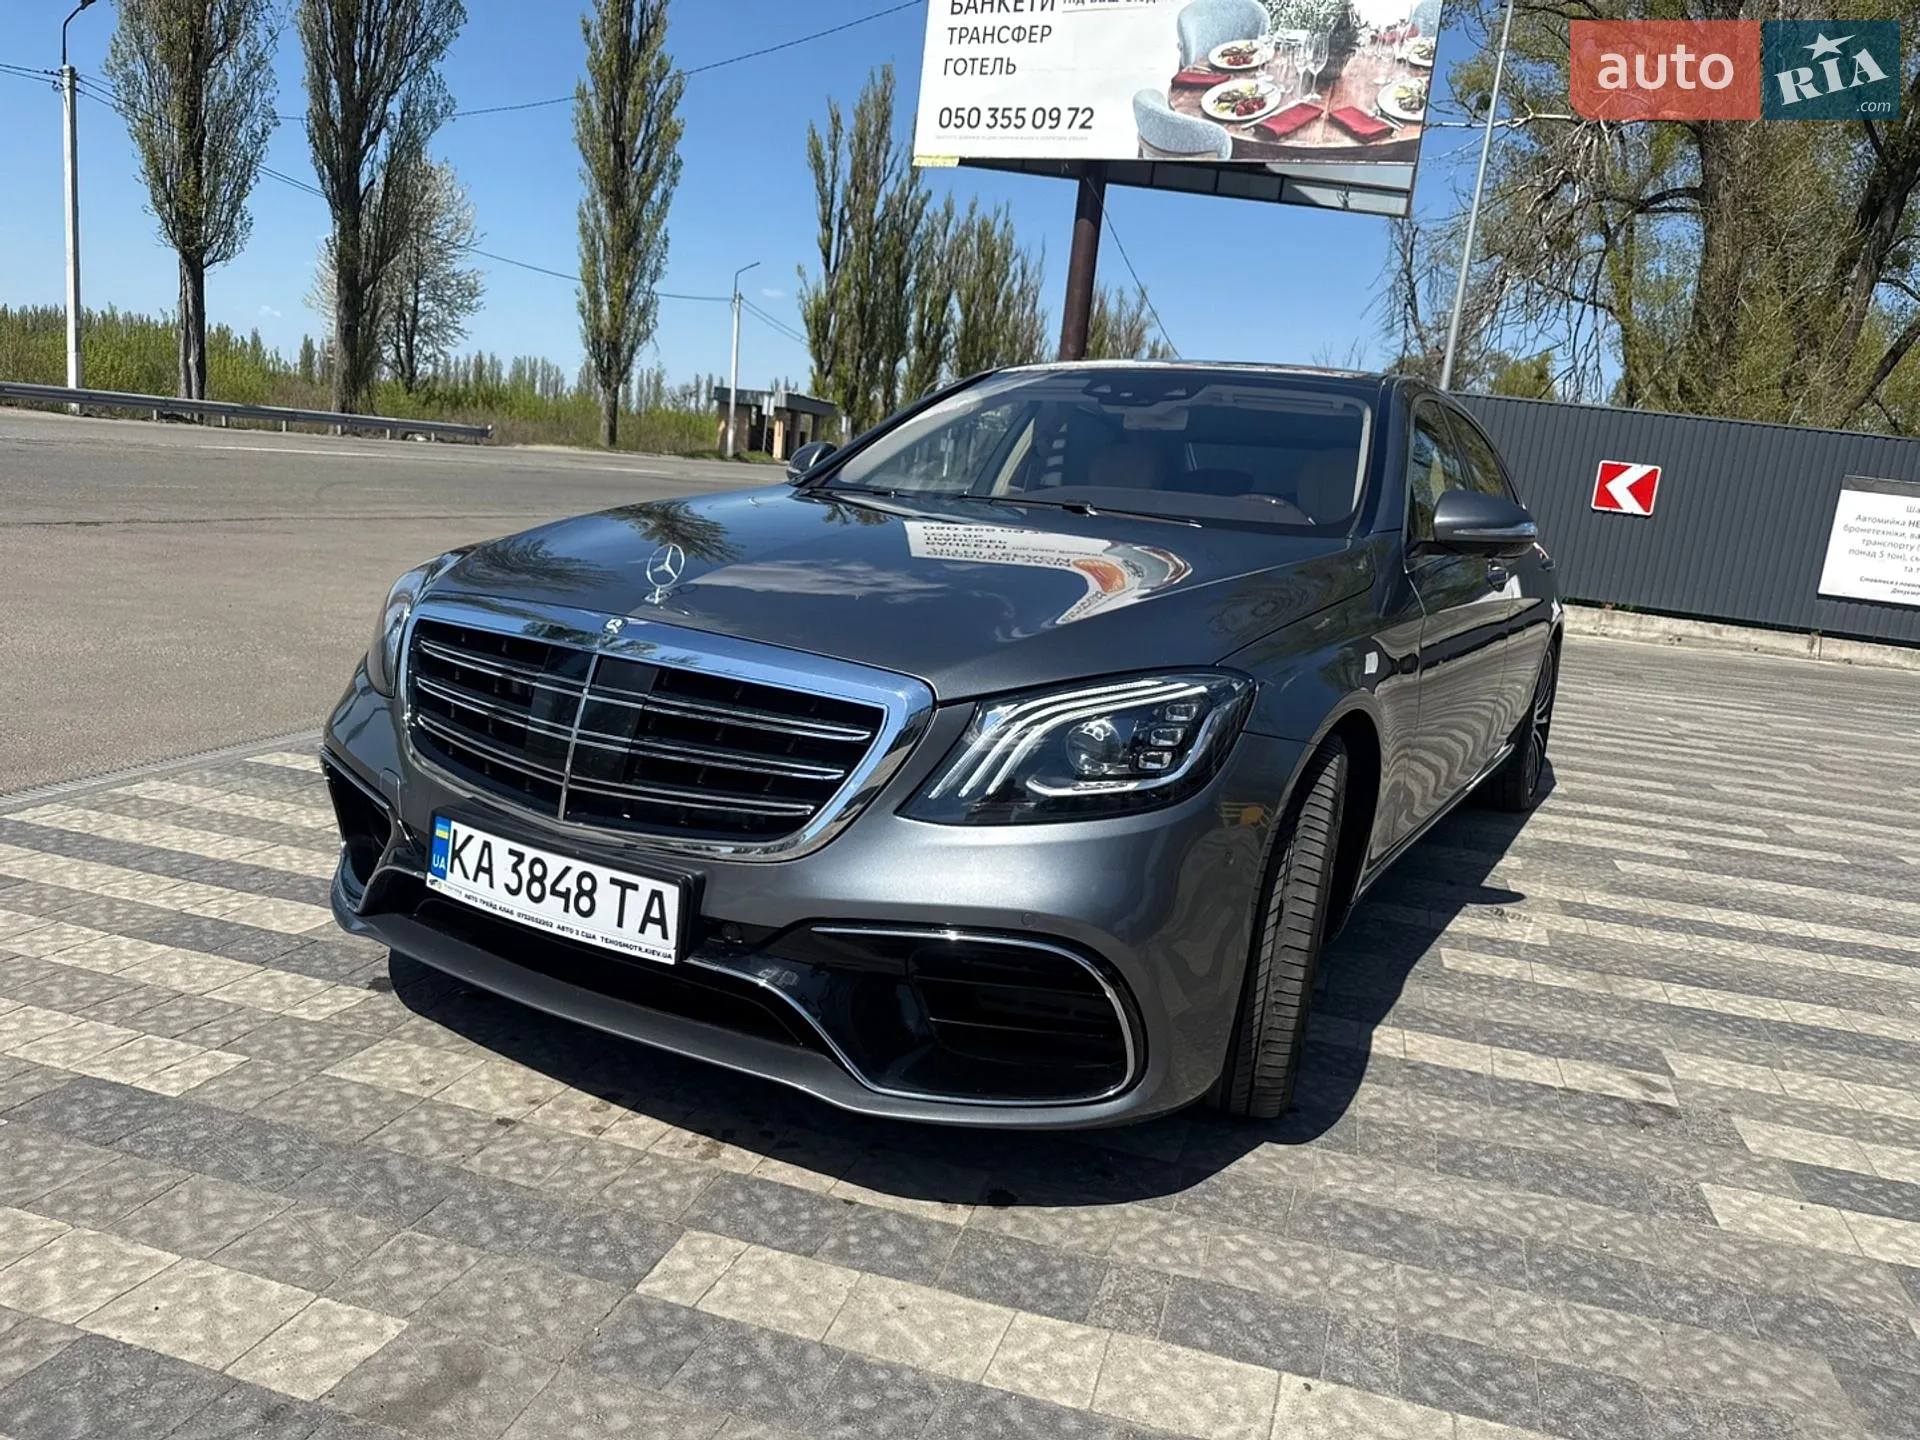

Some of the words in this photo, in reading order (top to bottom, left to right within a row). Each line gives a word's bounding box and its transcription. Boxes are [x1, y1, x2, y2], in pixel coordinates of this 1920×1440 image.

[949, 0, 1056, 16] БАНКЕТИ
[947, 25, 1053, 45] ТРАНСФЕР
[943, 57, 1017, 77] ГОТЕЛЬ
[938, 106, 982, 130] 050
[985, 106, 1027, 130] 355
[1031, 106, 1062, 130] 09
[1067, 106, 1095, 130] 72
[432, 853, 447, 871] UA
[449, 828, 495, 890] KA
[504, 847, 599, 919] 3848
[609, 876, 670, 941] TA
